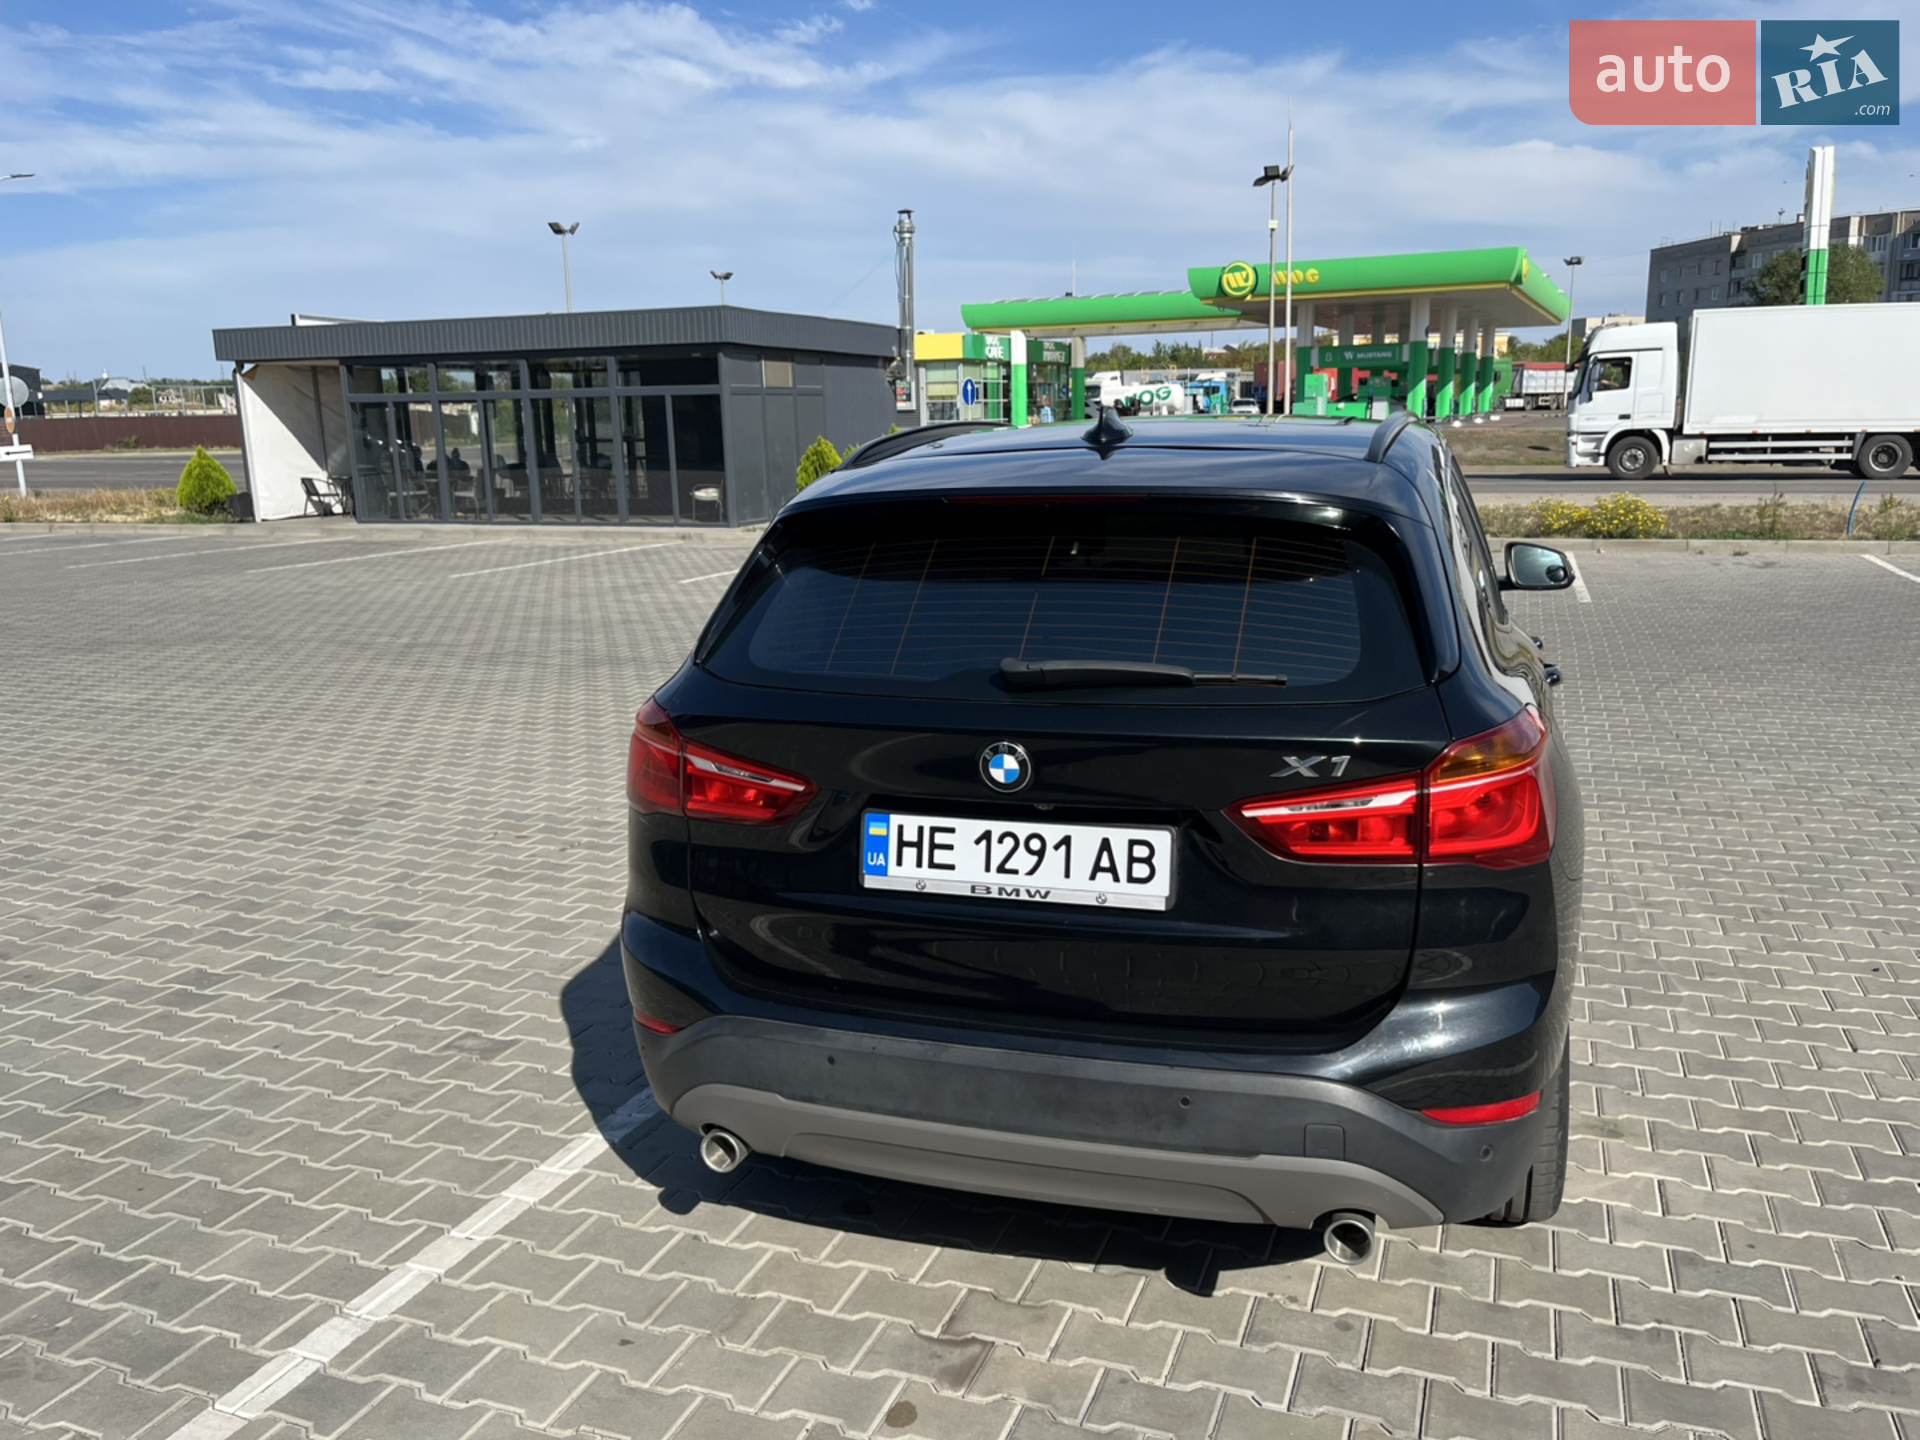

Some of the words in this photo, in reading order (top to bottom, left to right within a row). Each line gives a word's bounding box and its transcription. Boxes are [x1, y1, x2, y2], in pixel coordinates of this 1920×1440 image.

[1357, 351, 1392, 359] MUSTANG
[984, 744, 1025, 761] BMW
[1269, 755, 1351, 777] X1
[867, 852, 886, 866] UA
[896, 824, 956, 870] HE
[974, 830, 1072, 879] 1291
[1089, 837, 1156, 884] AB
[970, 884, 1051, 899] BMW
